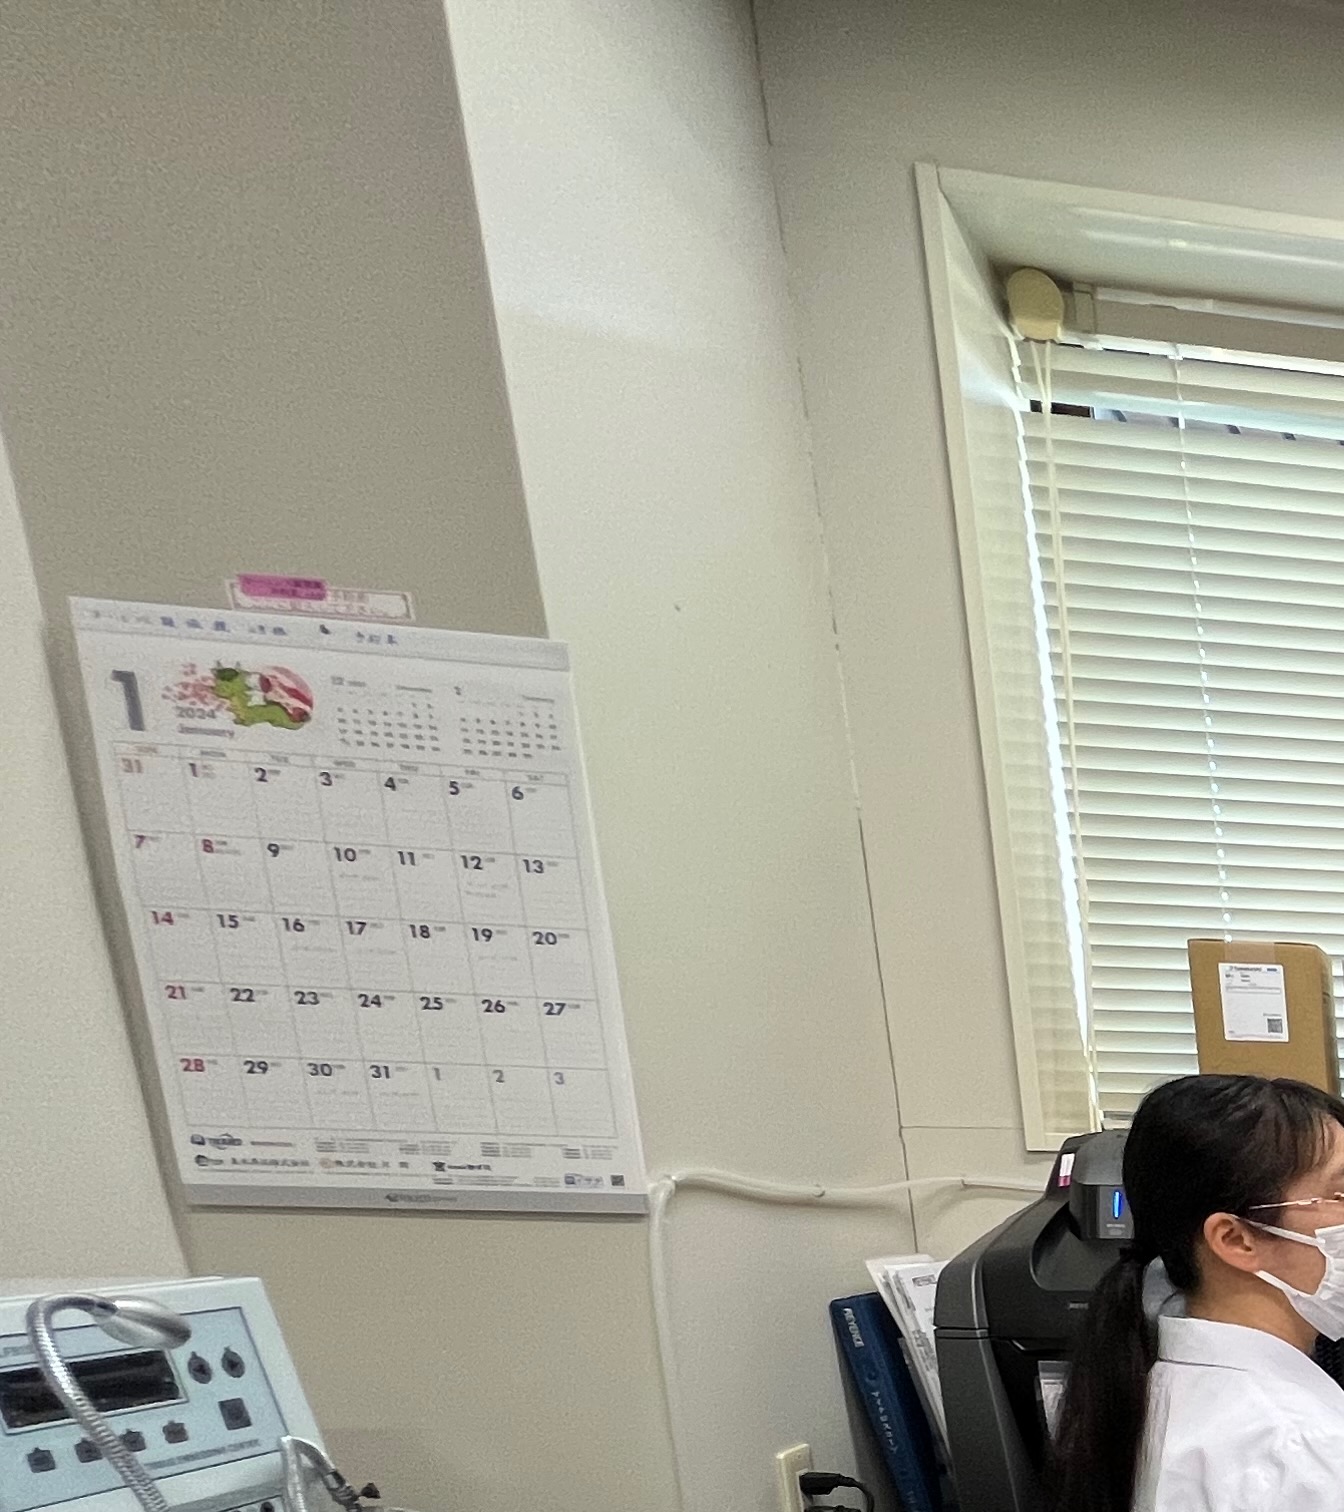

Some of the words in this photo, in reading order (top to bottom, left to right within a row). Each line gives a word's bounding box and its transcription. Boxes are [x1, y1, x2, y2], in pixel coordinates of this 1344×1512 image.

[110, 669, 145, 732] 1
[176, 705, 217, 720] 2024
[178, 724, 236, 739] January
[120, 756, 144, 774] 31
[189, 761, 200, 778] 1
[254, 766, 269, 784] 2
[319, 771, 334, 788] 3
[384, 776, 398, 792] 4
[448, 780, 460, 796] 5
[512, 785, 525, 801] 6
[134, 834, 147, 851] 7
[202, 838, 215, 855] 8
[267, 842, 281, 858] 9
[333, 846, 357, 863] 10
[397, 850, 417, 867] 11
[460, 853, 484, 871] 12
[522, 858, 545, 875] 13
[150, 909, 174, 927] 14
[216, 913, 240, 930] 15
[281, 916, 305, 934] 16
[345, 920, 367, 937] 17
[409, 923, 431, 940] 18
[472, 926, 494, 944] 19
[532, 930, 559, 947] 20
[165, 983, 187, 1001] 21
[229, 986, 256, 1003] 22
[294, 990, 321, 1006] 23
[358, 993, 383, 1009] 24
[420, 995, 445, 1012] 25
[481, 998, 507, 1015] 26
[543, 1001, 567, 1017] 27
[180, 1057, 205, 1073] 28
[243, 1059, 269, 1076] 29
[307, 1061, 333, 1079] 30
[370, 1064, 391, 1081] 31
[432, 1067, 441, 1082] 1
[492, 1069, 505, 1084] 2
[553, 1071, 565, 1086] 3
